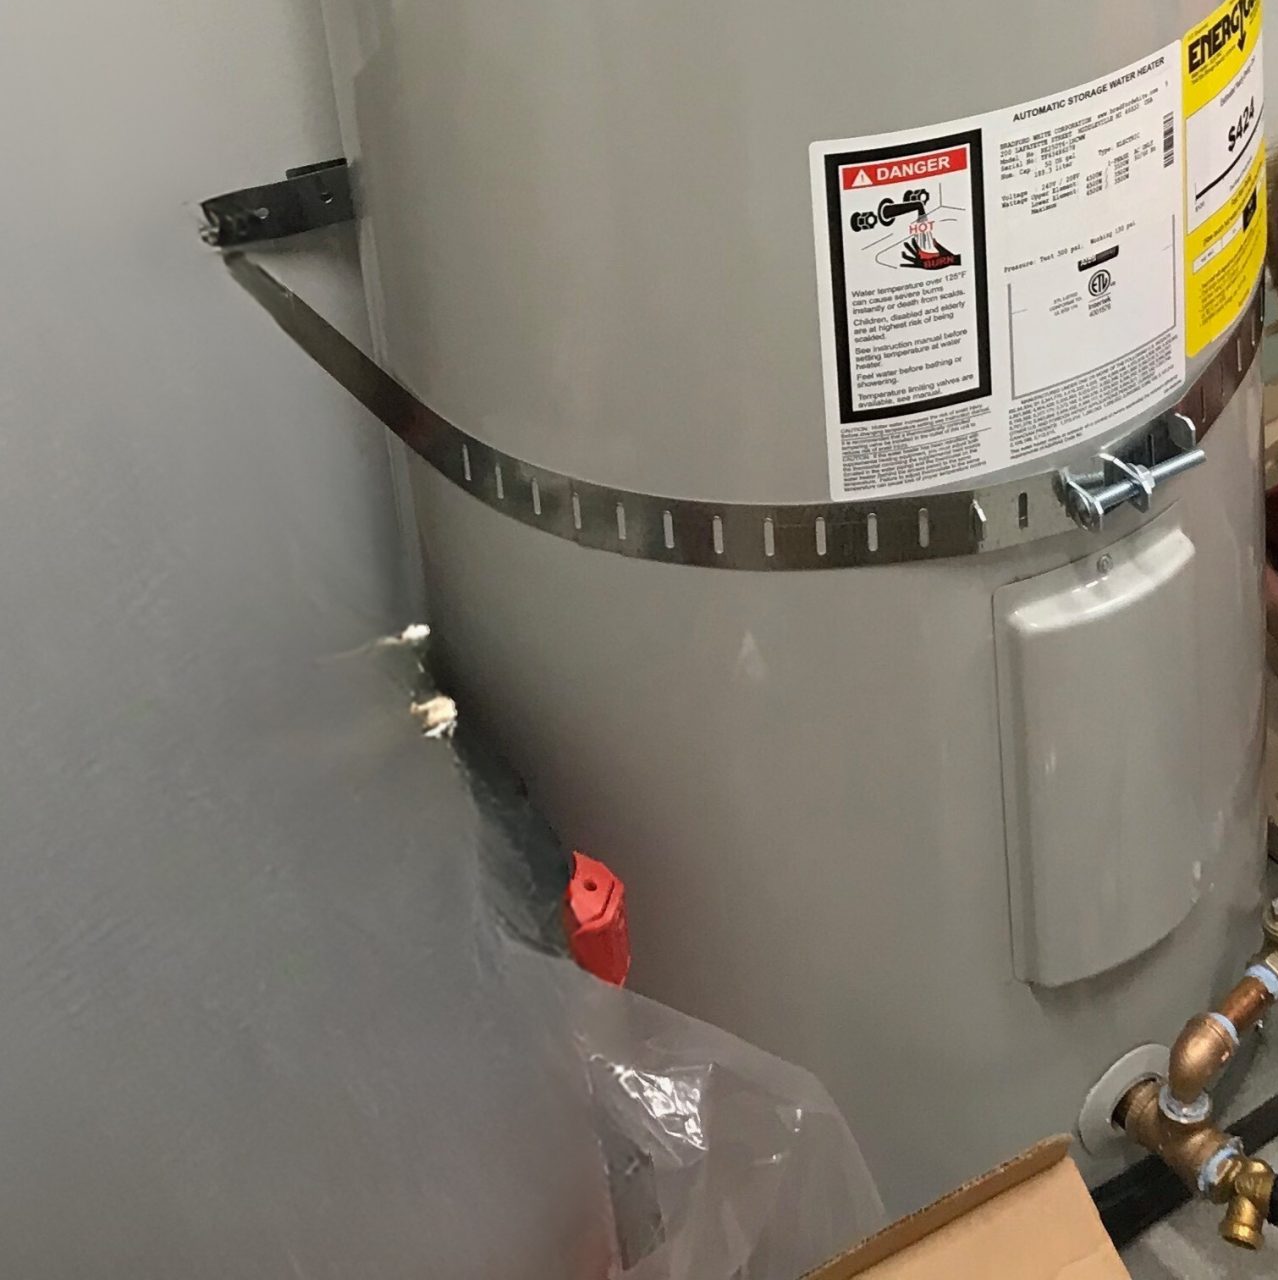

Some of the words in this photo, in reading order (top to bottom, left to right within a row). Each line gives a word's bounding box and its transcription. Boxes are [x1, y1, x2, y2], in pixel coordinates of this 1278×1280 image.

[1013, 100, 1066, 122] AUTOMATIC
[1068, 84, 1108, 106] STORAGE
[1110, 72, 1136, 90] WATER
[1137, 56, 1165, 77] HEATER
[876, 156, 951, 181] DANGER
[908, 221, 936, 235] HOT
[924, 256, 954, 269] BURN
[852, 288, 876, 298] Water
[878, 282, 924, 295] temperature
[926, 278, 942, 287] over
[944, 270, 967, 282] 125°F
[868, 296, 893, 304] cause
[894, 291, 920, 300] severe
[922, 285, 944, 295] burns
[853, 316, 889, 327] Children,
[890, 310, 922, 321] disabled
[924, 306, 939, 315] and
[940, 300, 966, 312] elderly
